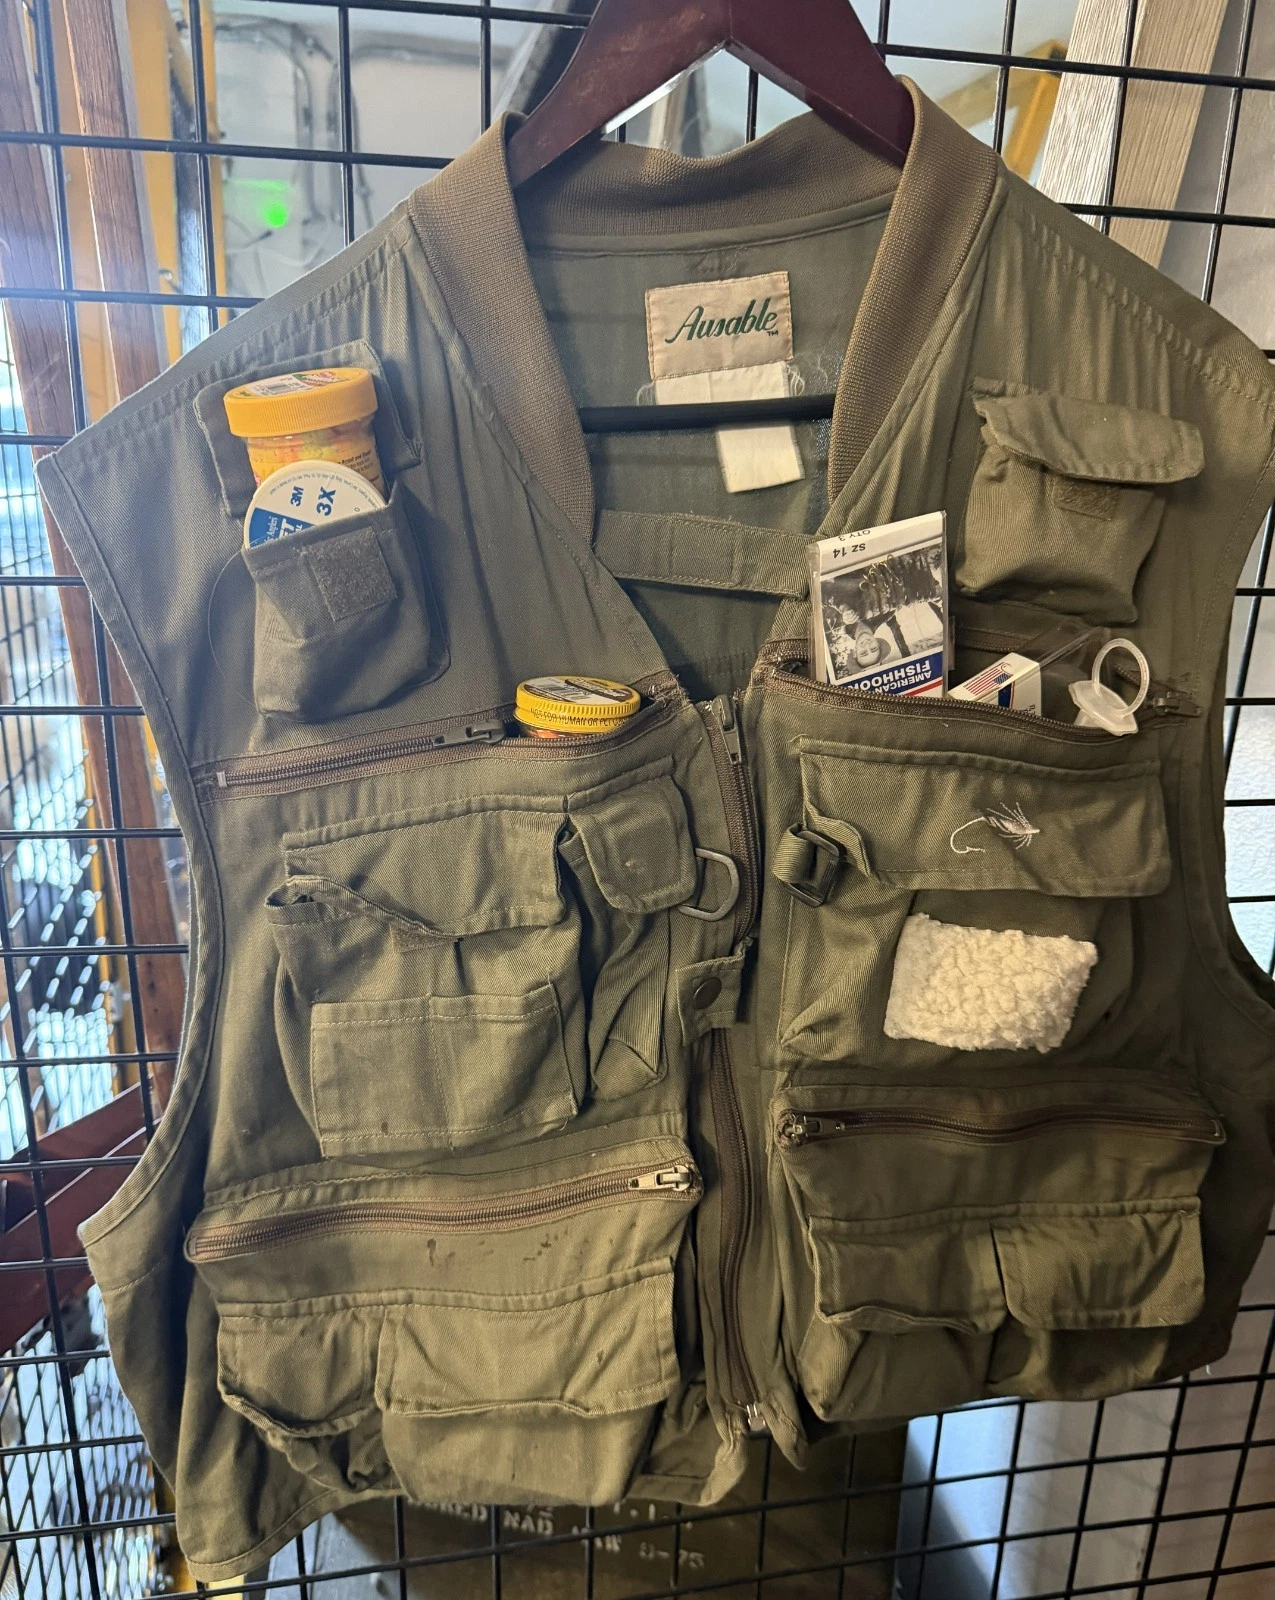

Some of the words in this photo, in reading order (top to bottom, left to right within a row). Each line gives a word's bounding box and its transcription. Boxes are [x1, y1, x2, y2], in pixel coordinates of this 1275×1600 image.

[665, 297, 778, 343] Ausable
[290, 485, 304, 507] 3M
[316, 485, 336, 516] 3X
[837, 534, 846, 542] 3
[848, 529, 871, 540] QTY
[832, 548, 848, 559] 14
[851, 543, 866, 553] SZ
[875, 670, 932, 694] AMERICAN
[559, 714, 587, 726] HUMAN
[587, 717, 598, 727] OR
